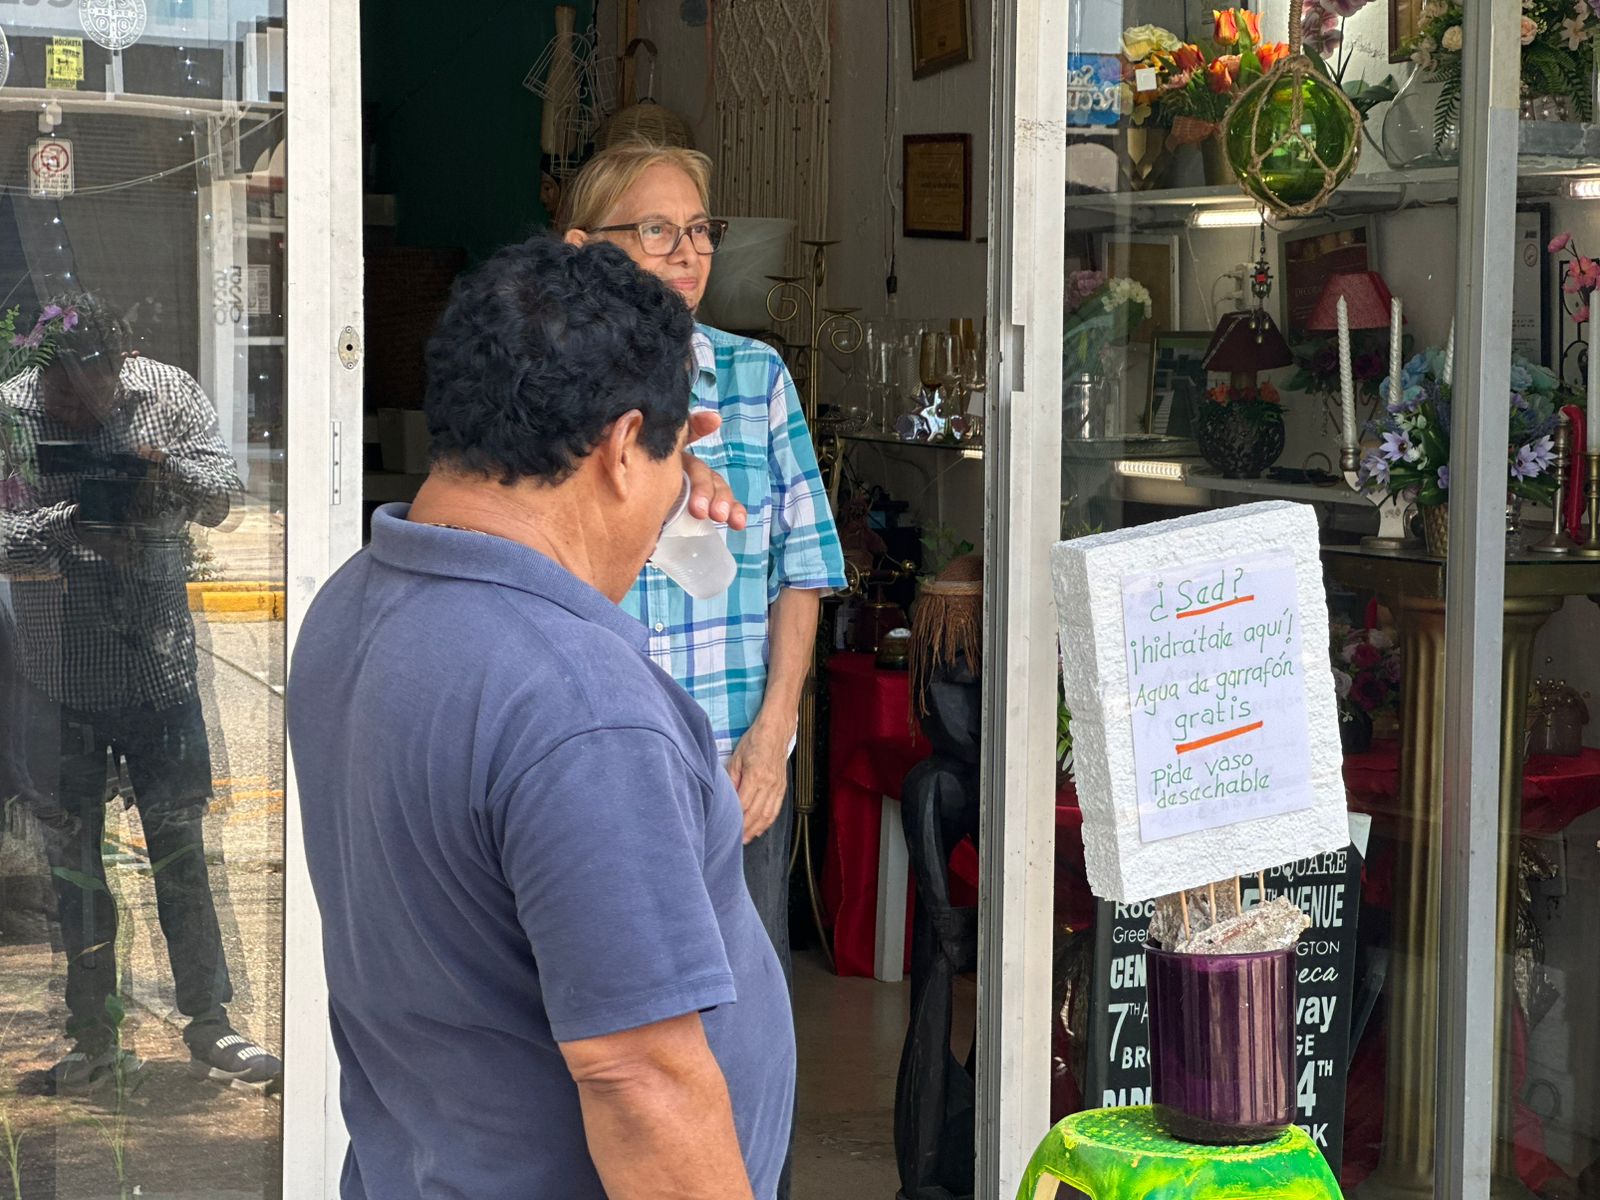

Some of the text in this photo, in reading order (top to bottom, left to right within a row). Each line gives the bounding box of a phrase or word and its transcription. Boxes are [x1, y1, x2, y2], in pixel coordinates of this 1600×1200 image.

[1244, 608, 1293, 653] aquí!
[1135, 651, 1294, 715] Agua de garrafón
[1172, 696, 1251, 741] gratis
[1151, 753, 1254, 796] Pide vaso
[1157, 768, 1270, 808] desechable
[1283, 884, 1345, 929] ENUE
